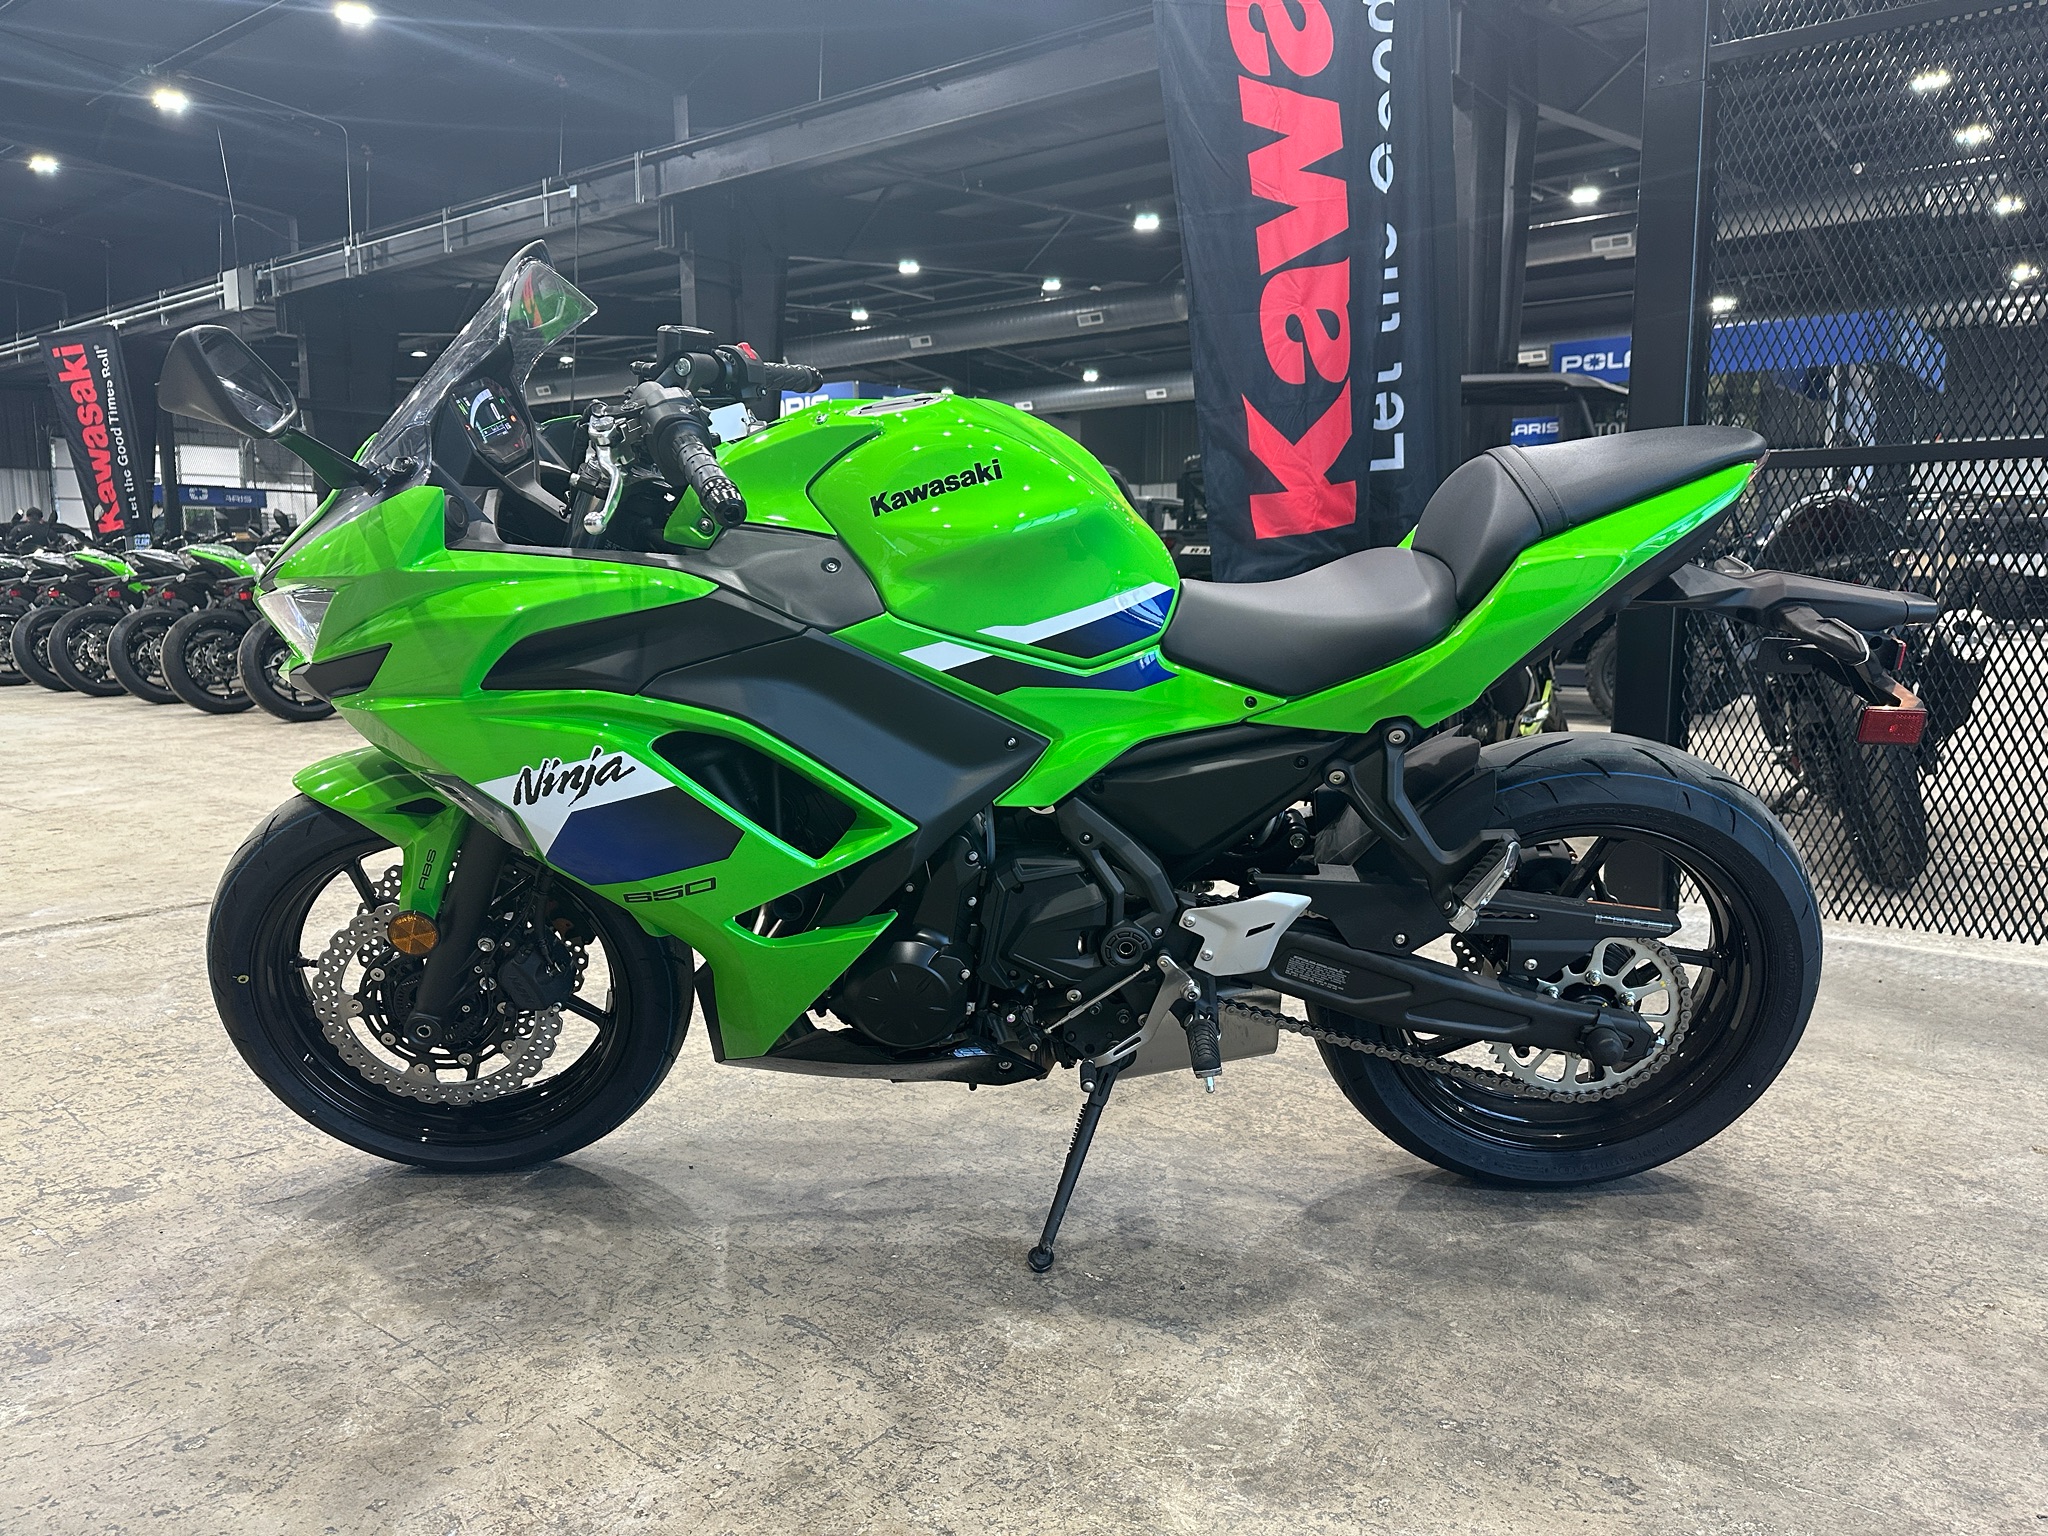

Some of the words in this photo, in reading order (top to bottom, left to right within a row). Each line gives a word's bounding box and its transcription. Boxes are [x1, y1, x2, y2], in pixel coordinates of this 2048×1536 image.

[52, 344, 125, 533] Kawasaki
[110, 427, 129, 467] Good
[1510, 421, 1559, 437] ARIS
[128, 496, 139, 519] Let
[869, 458, 1003, 518] Kawasaki
[512, 747, 636, 808] Ninja
[418, 848, 436, 891] ABS
[623, 877, 716, 903] 650
